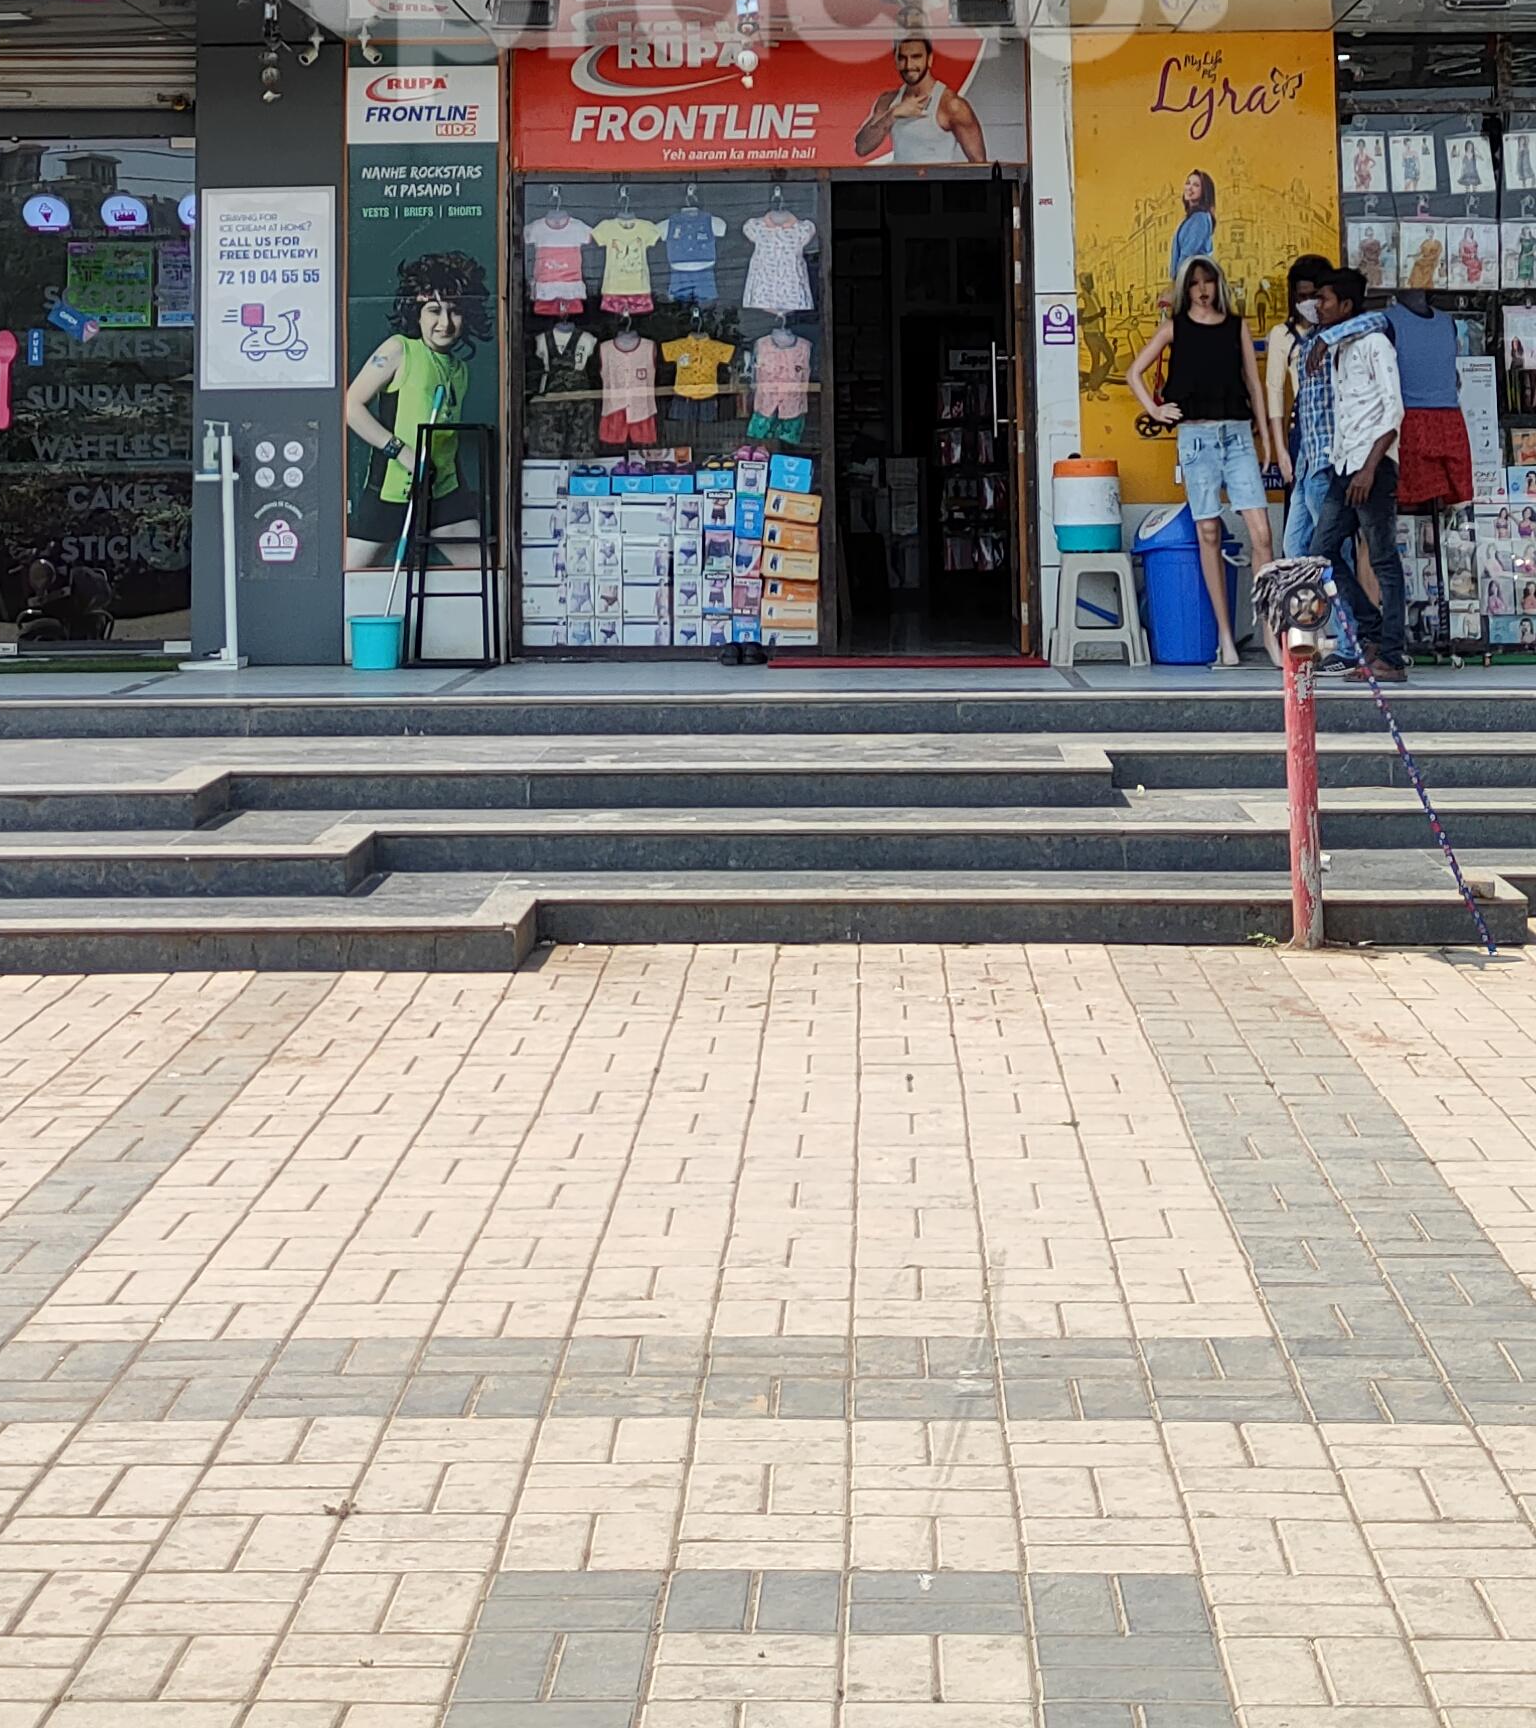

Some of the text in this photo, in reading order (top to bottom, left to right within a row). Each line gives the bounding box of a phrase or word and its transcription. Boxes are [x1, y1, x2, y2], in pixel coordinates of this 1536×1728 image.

[386, 76, 448, 90] RUPA
[1151, 57, 1281, 140] Lyra
[365, 105, 480, 123] FRONTLINE
[570, 103, 821, 142] FRONTLINE
[435, 124, 477, 136] KIDZ
[662, 148, 686, 161] Yeh
[689, 149, 726, 160] aaram
[729, 148, 745, 159] ka
[747, 147, 789, 160] mamla
[361, 165, 483, 180] NANHE ROCKSTARS
[400, 184, 453, 198] PASAND
[219, 235, 300, 247] CALL US FOR
[219, 249, 250, 260] FREE
